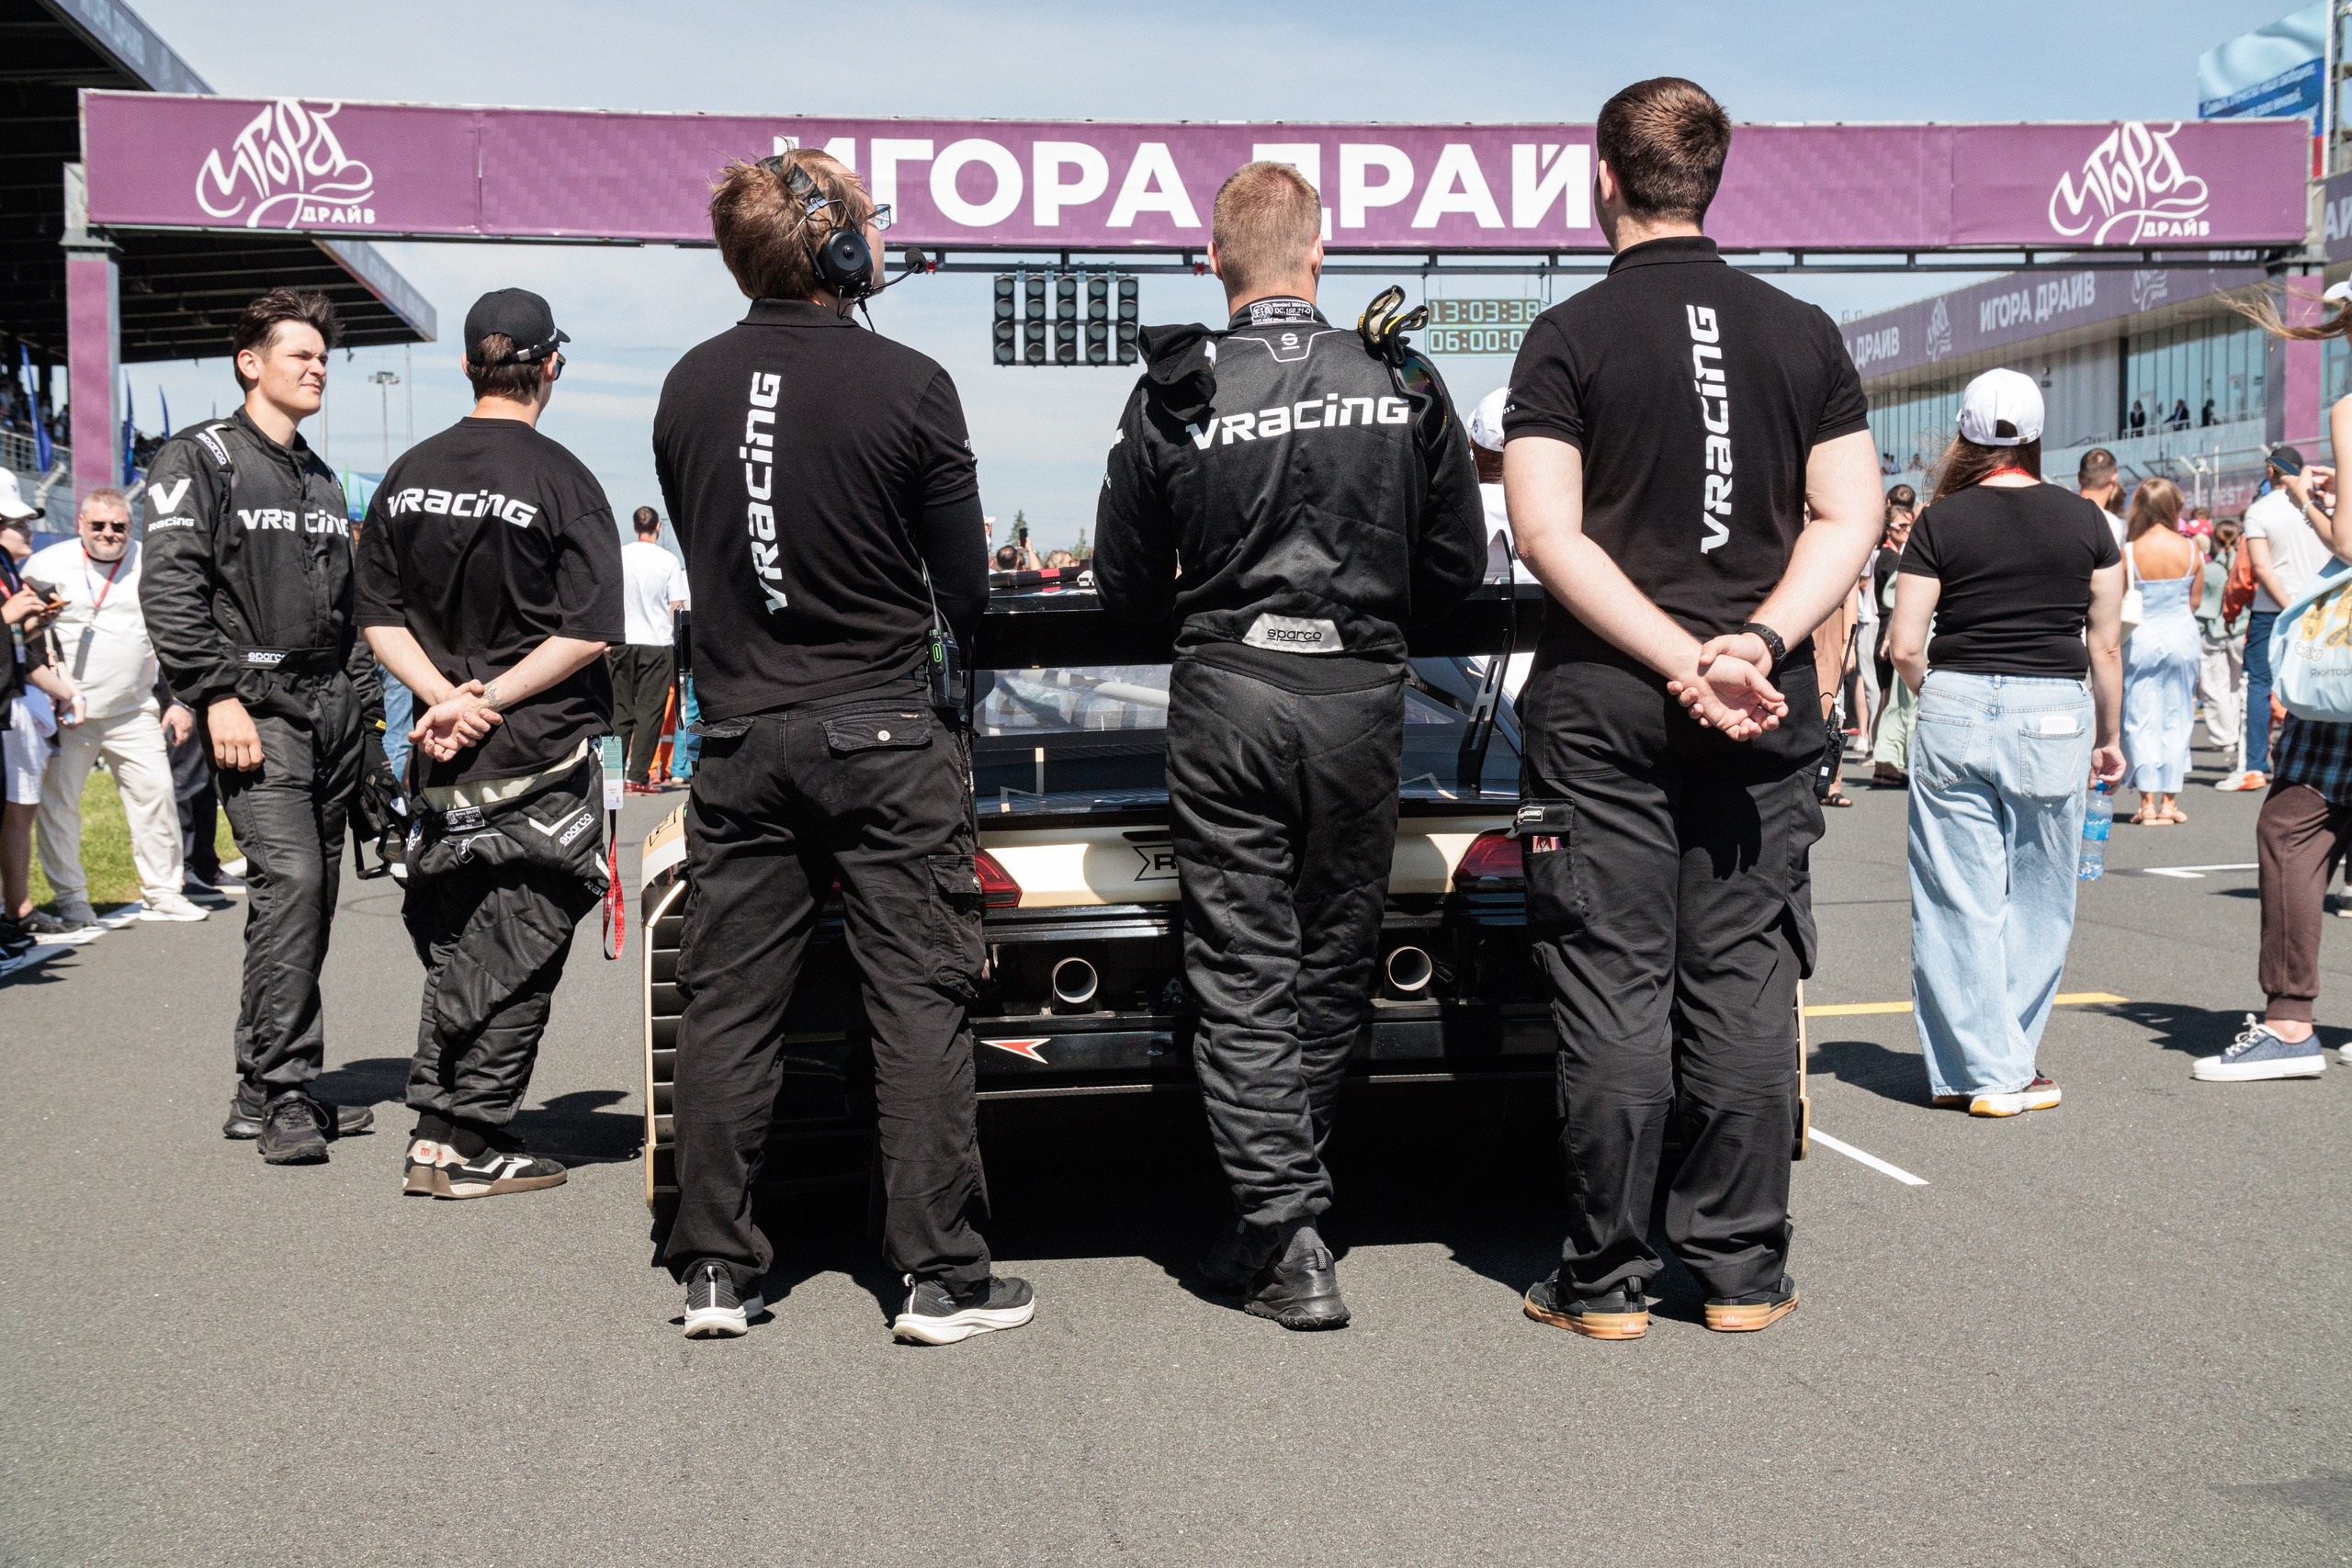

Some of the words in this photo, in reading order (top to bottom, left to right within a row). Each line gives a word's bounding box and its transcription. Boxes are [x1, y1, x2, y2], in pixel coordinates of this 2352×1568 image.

[774, 136, 1201, 228] ГОРА
[1252, 142, 1591, 241] РАЙ
[300, 205, 376, 224] ДРАЙВ
[2142, 218, 2211, 237] ДРАЙВ
[1431, 301, 1540, 322] 13:03:38
[1980, 288, 2033, 333] ИГОРА
[1430, 331, 1525, 352] 06:00:0
[195, 432, 227, 467] sparco
[148, 479, 192, 515] V
[1267, 627, 1323, 642] sparco
[2310, 668, 2352, 678] Якитор
[559, 812, 595, 848] sparco
[1154, 853, 1178, 871] R
